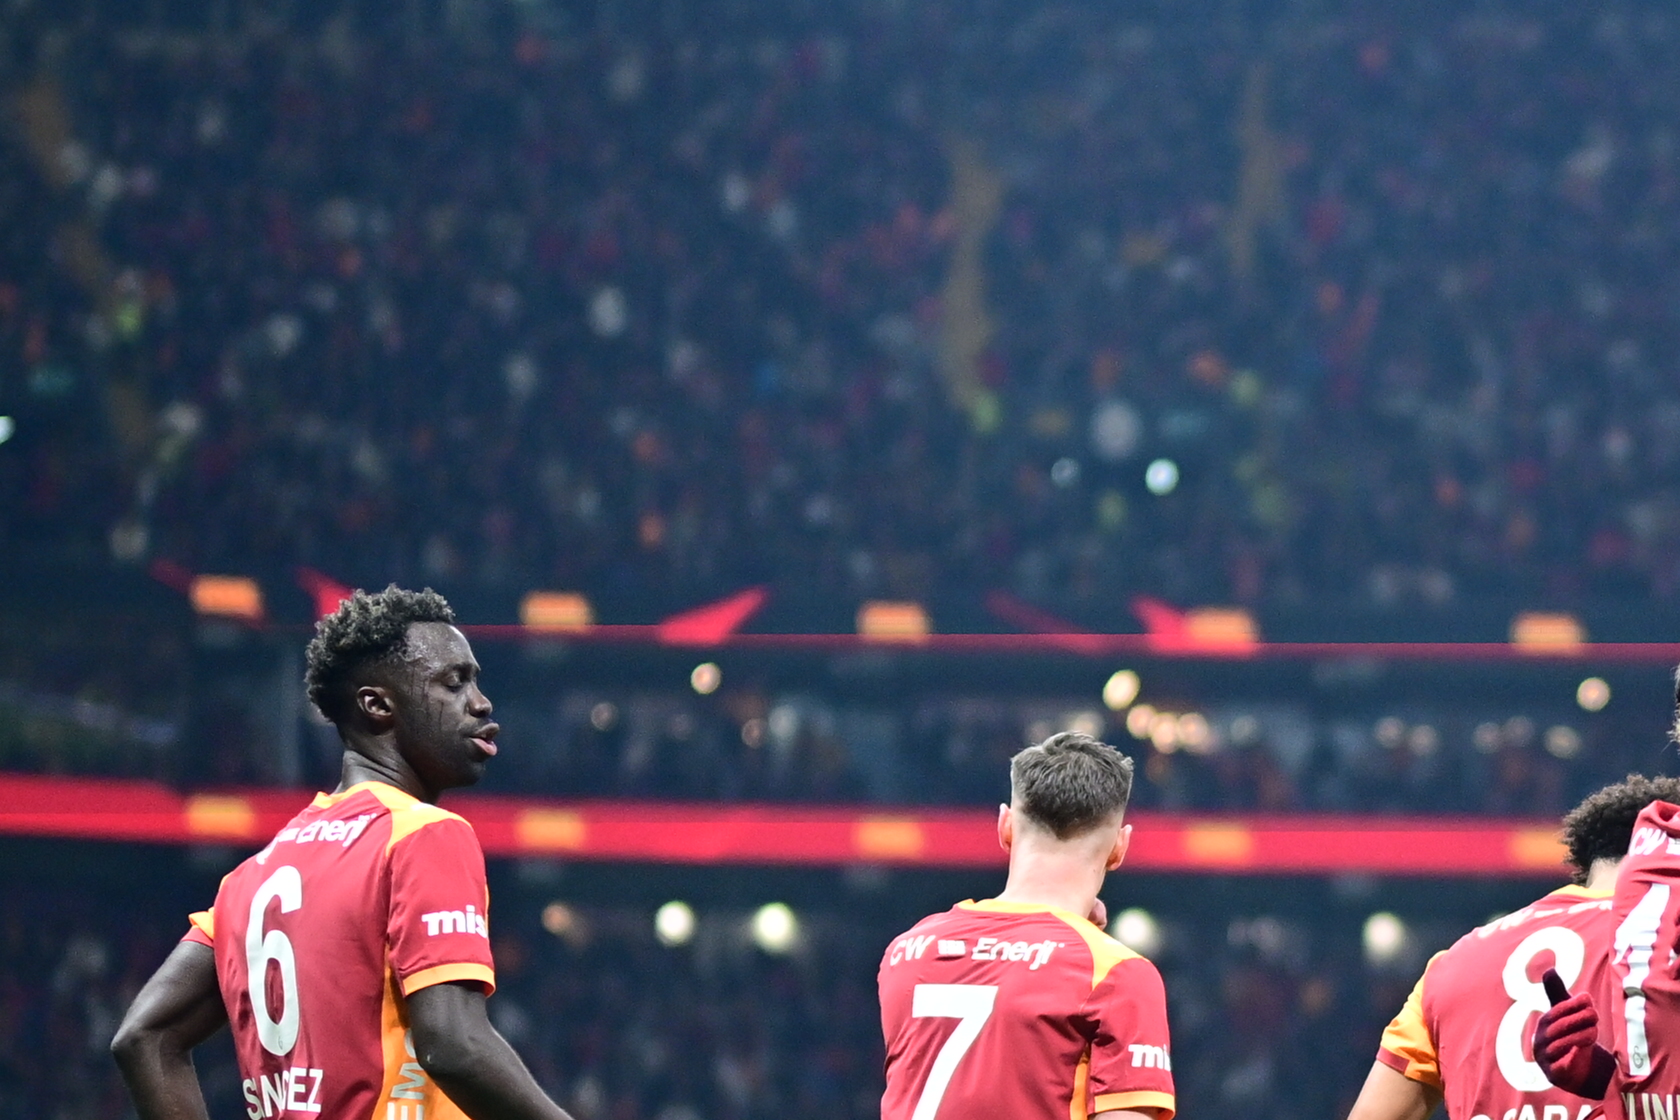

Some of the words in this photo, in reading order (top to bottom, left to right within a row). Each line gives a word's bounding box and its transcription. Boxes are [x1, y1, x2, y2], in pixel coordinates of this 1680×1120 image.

[1628, 827, 1667, 857] CW
[245, 865, 303, 1057] 6
[889, 935, 936, 967] CW
[971, 937, 1058, 971] Enerji
[1495, 926, 1585, 1092] 8
